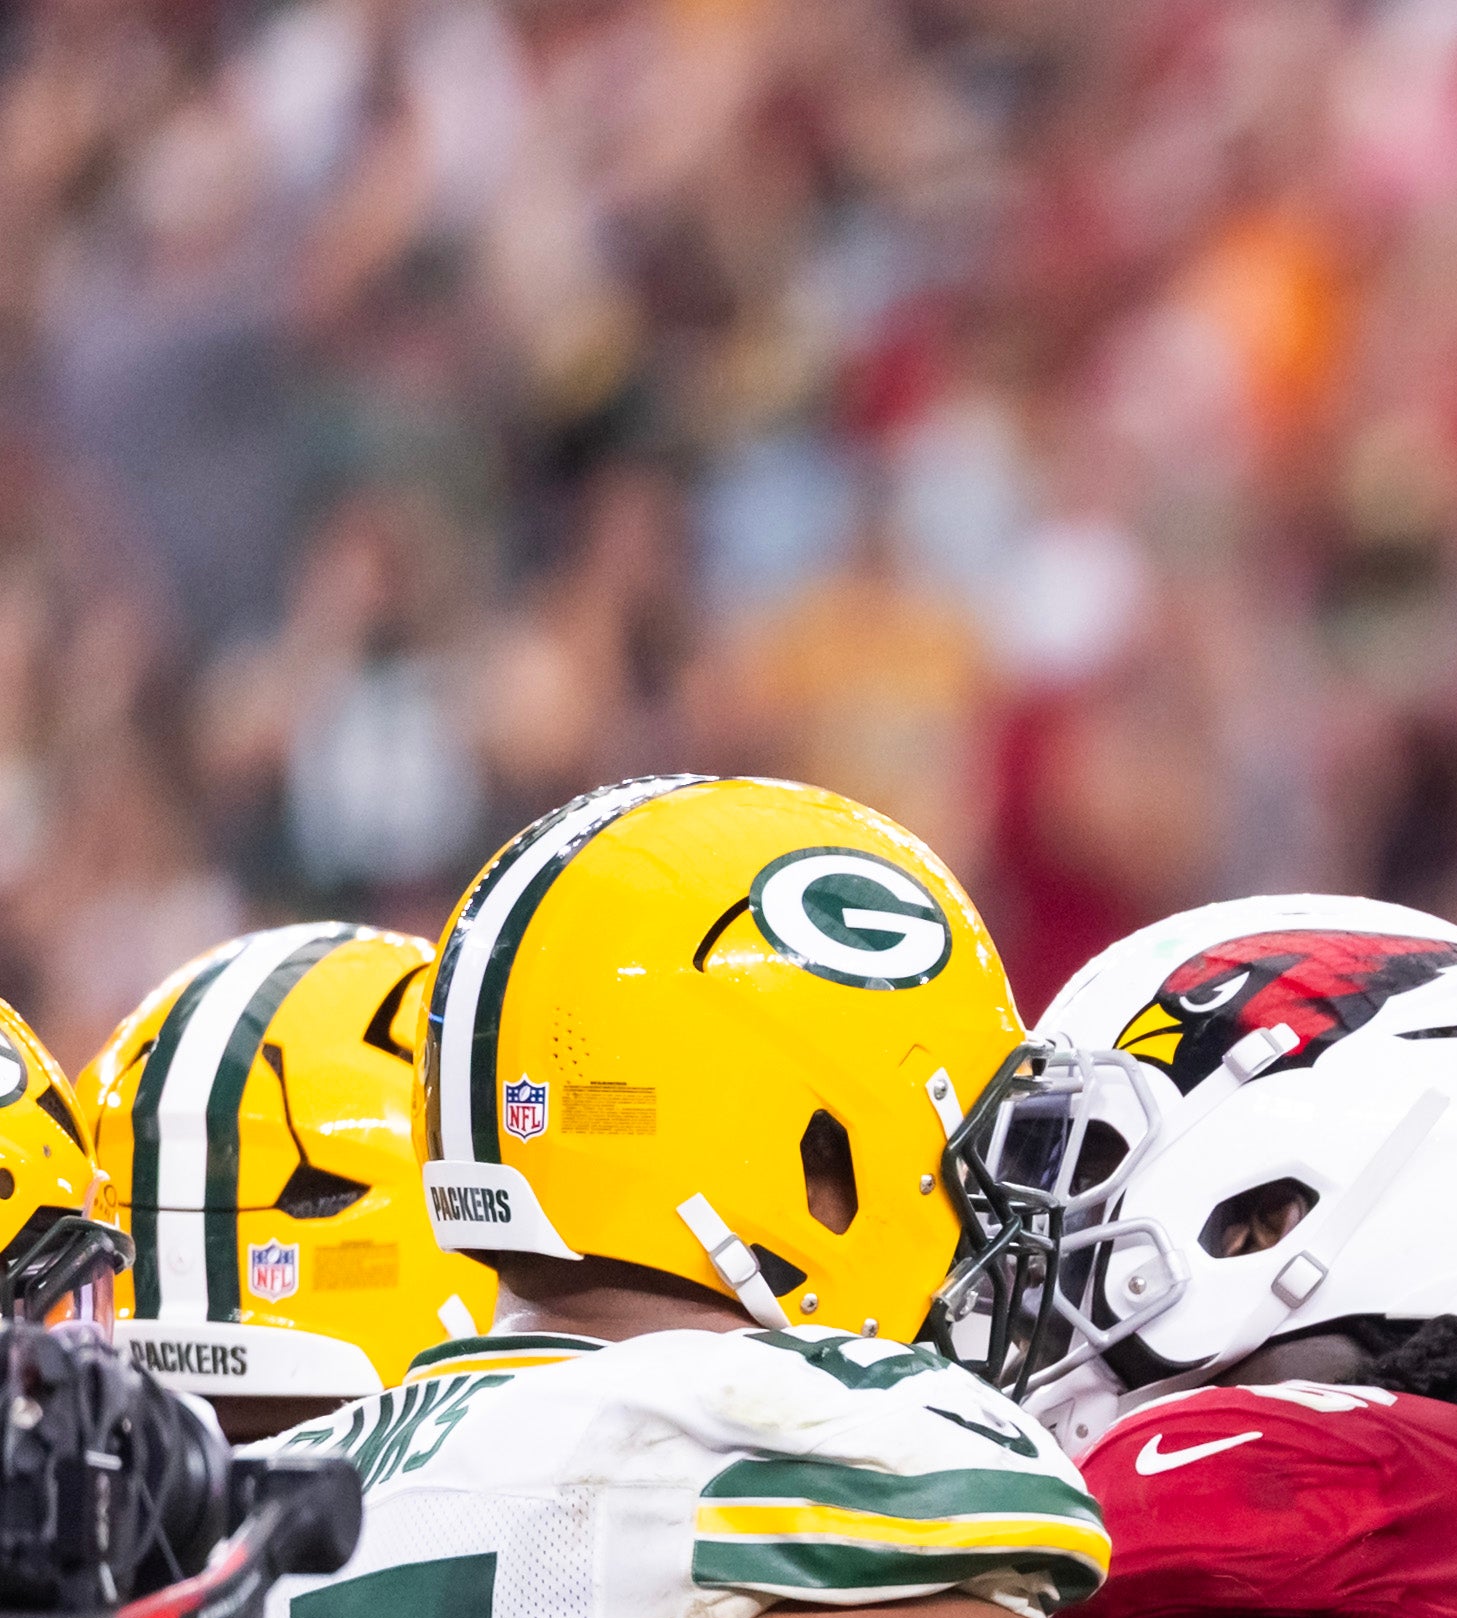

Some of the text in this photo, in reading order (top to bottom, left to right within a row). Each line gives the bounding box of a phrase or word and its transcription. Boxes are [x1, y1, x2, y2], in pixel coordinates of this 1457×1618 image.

[509, 1105, 541, 1132] NFL
[430, 1186, 512, 1223] PACKERS
[256, 1267, 292, 1290] NFL
[129, 1339, 248, 1376] PACKERS
